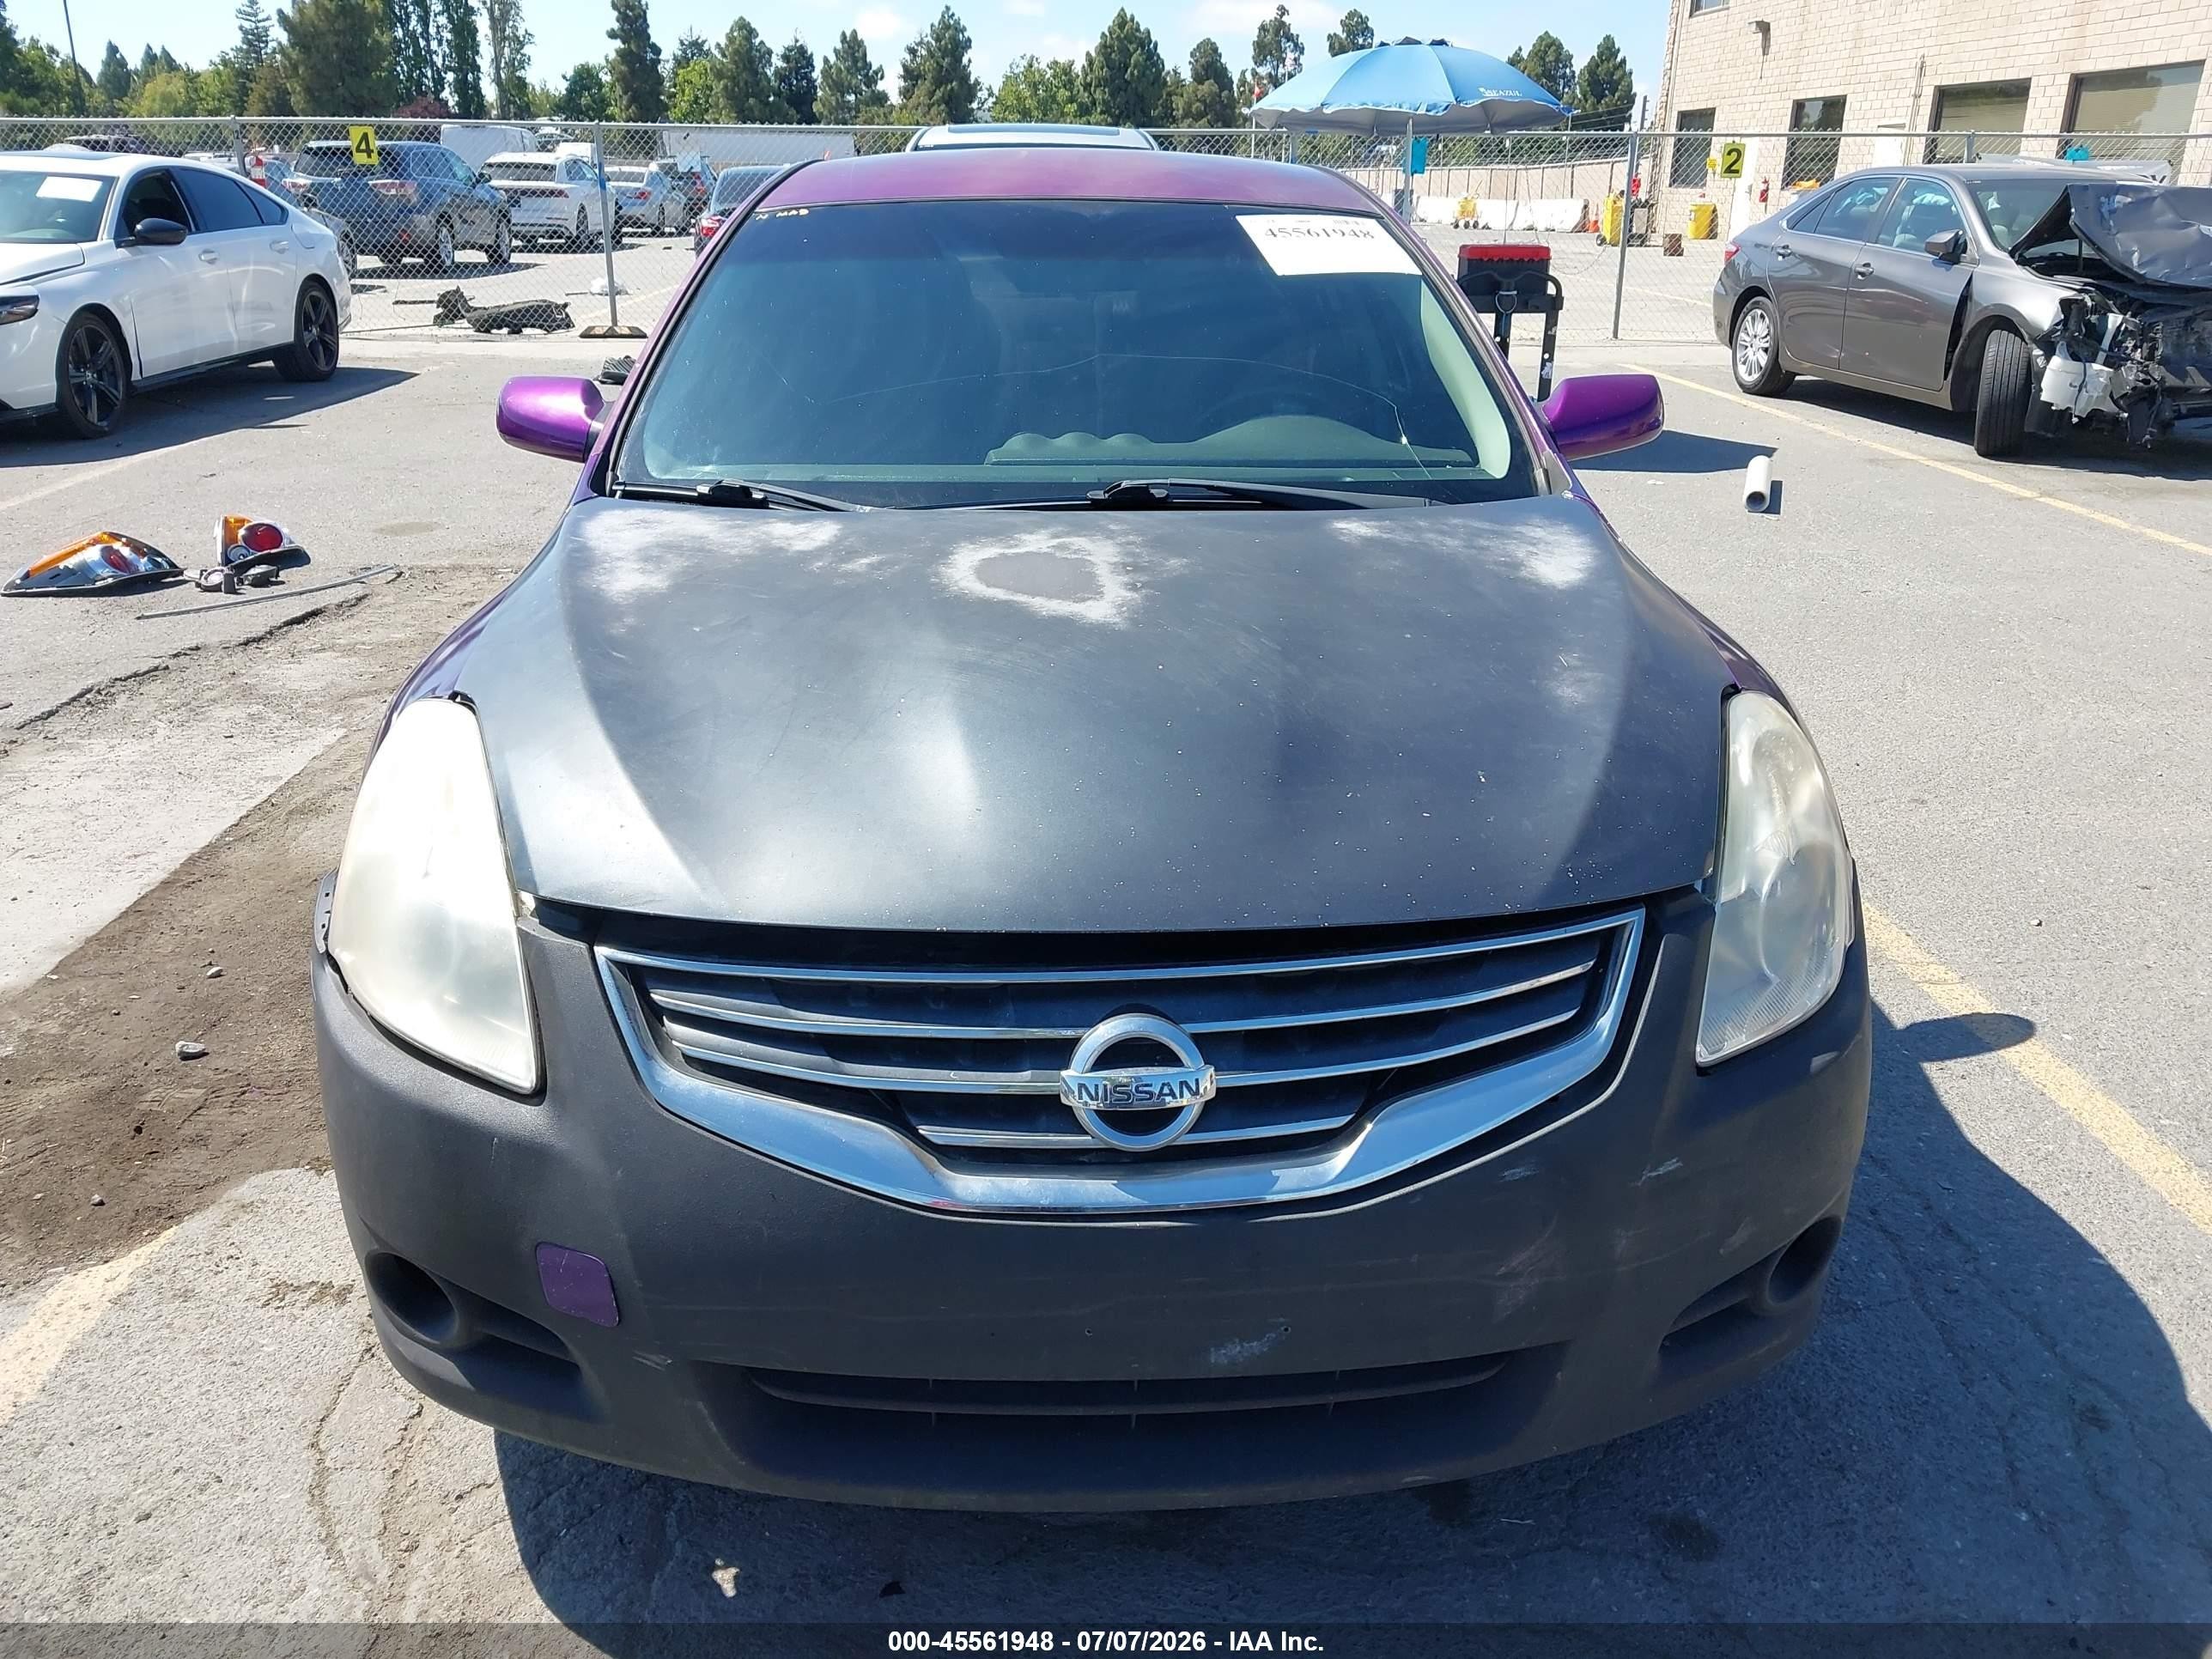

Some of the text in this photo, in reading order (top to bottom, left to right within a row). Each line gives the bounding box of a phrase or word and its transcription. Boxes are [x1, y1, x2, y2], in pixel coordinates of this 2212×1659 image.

[355, 131, 374, 159] 4
[1723, 148, 1742, 174] 2
[1265, 228, 1375, 239] 45561948
[1077, 1078, 1200, 1103] NISSAN
